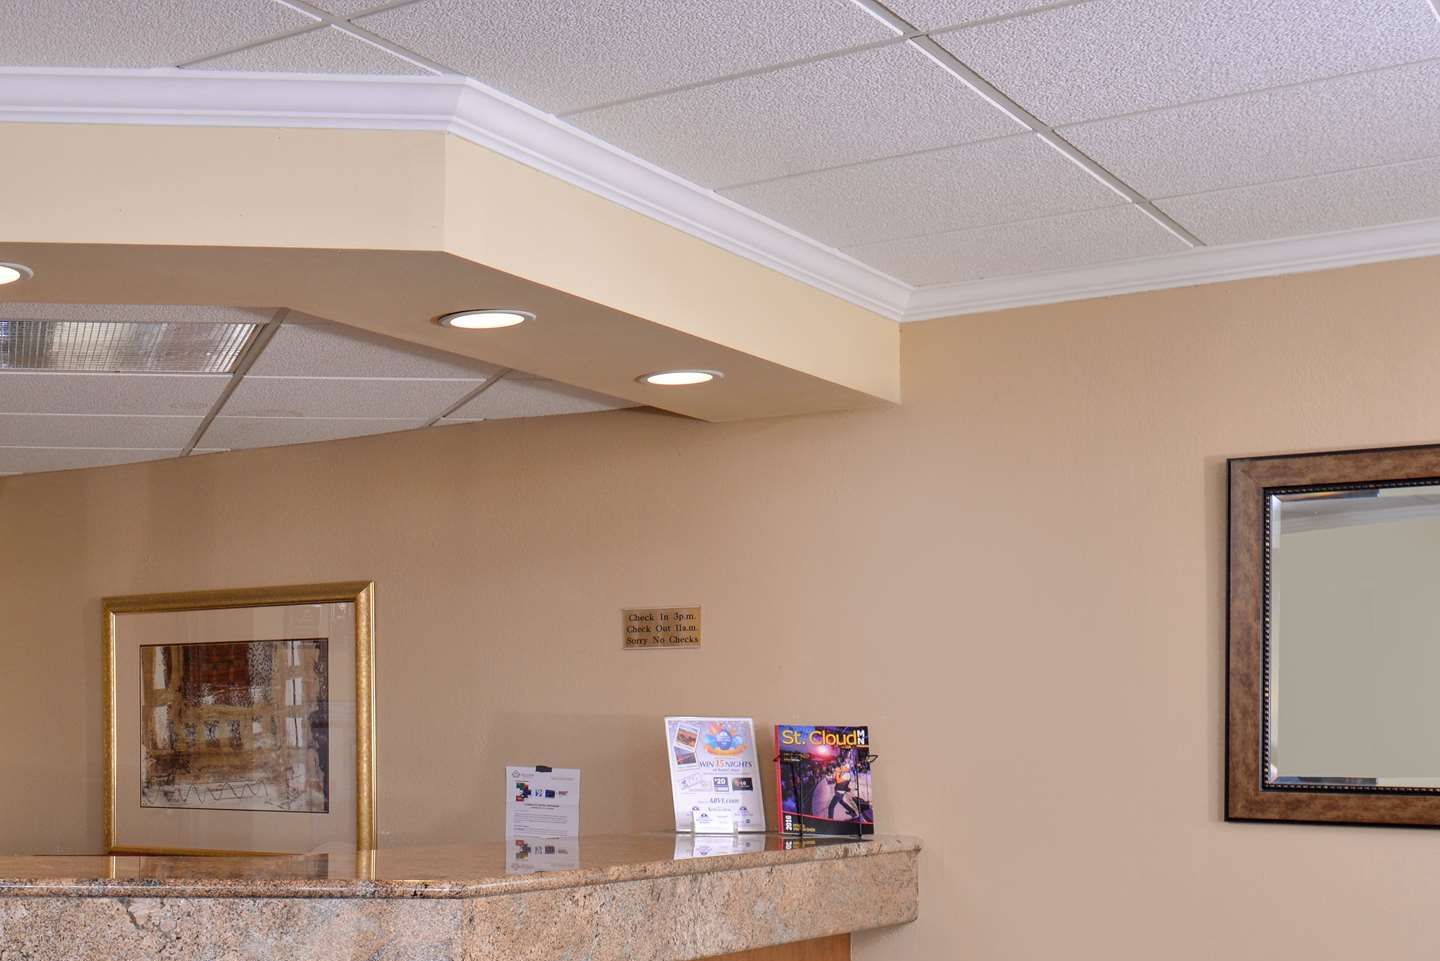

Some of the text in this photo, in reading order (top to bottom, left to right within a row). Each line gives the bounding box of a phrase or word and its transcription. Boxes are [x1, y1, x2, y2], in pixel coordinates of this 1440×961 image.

[628, 613, 654, 621] Check
[626, 625, 651, 633] Check
[626, 637, 648, 645] Sorry
[669, 635, 698, 643] Checks
[782, 729, 857, 746] St. Cloud
